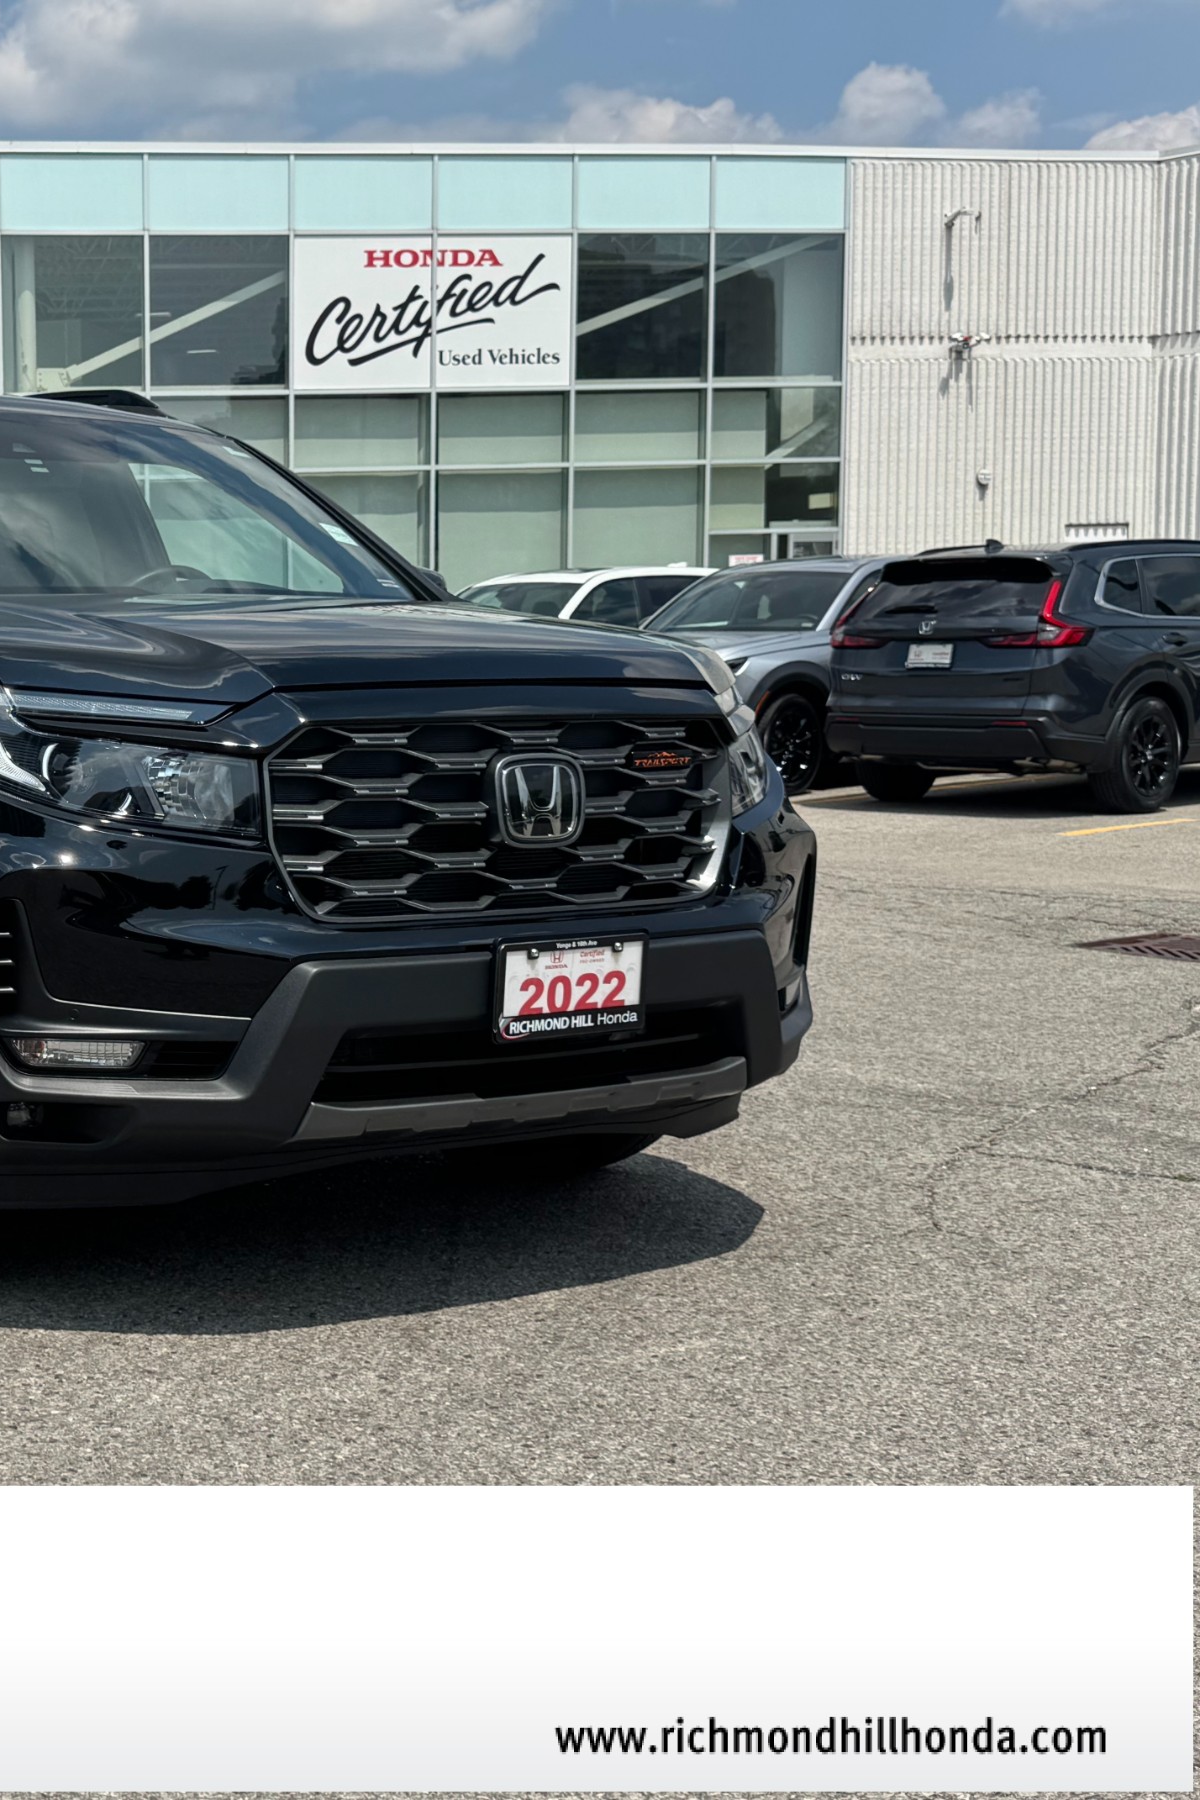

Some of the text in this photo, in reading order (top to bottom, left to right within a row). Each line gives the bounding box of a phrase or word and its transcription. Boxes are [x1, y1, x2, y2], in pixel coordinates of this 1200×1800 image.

[363, 249, 503, 268] HONDA
[305, 252, 560, 366] Certified
[438, 348, 560, 366] Used Vehicles
[518, 970, 627, 1016] 2022
[508, 1010, 638, 1034] RICHMOND HILL Honda
